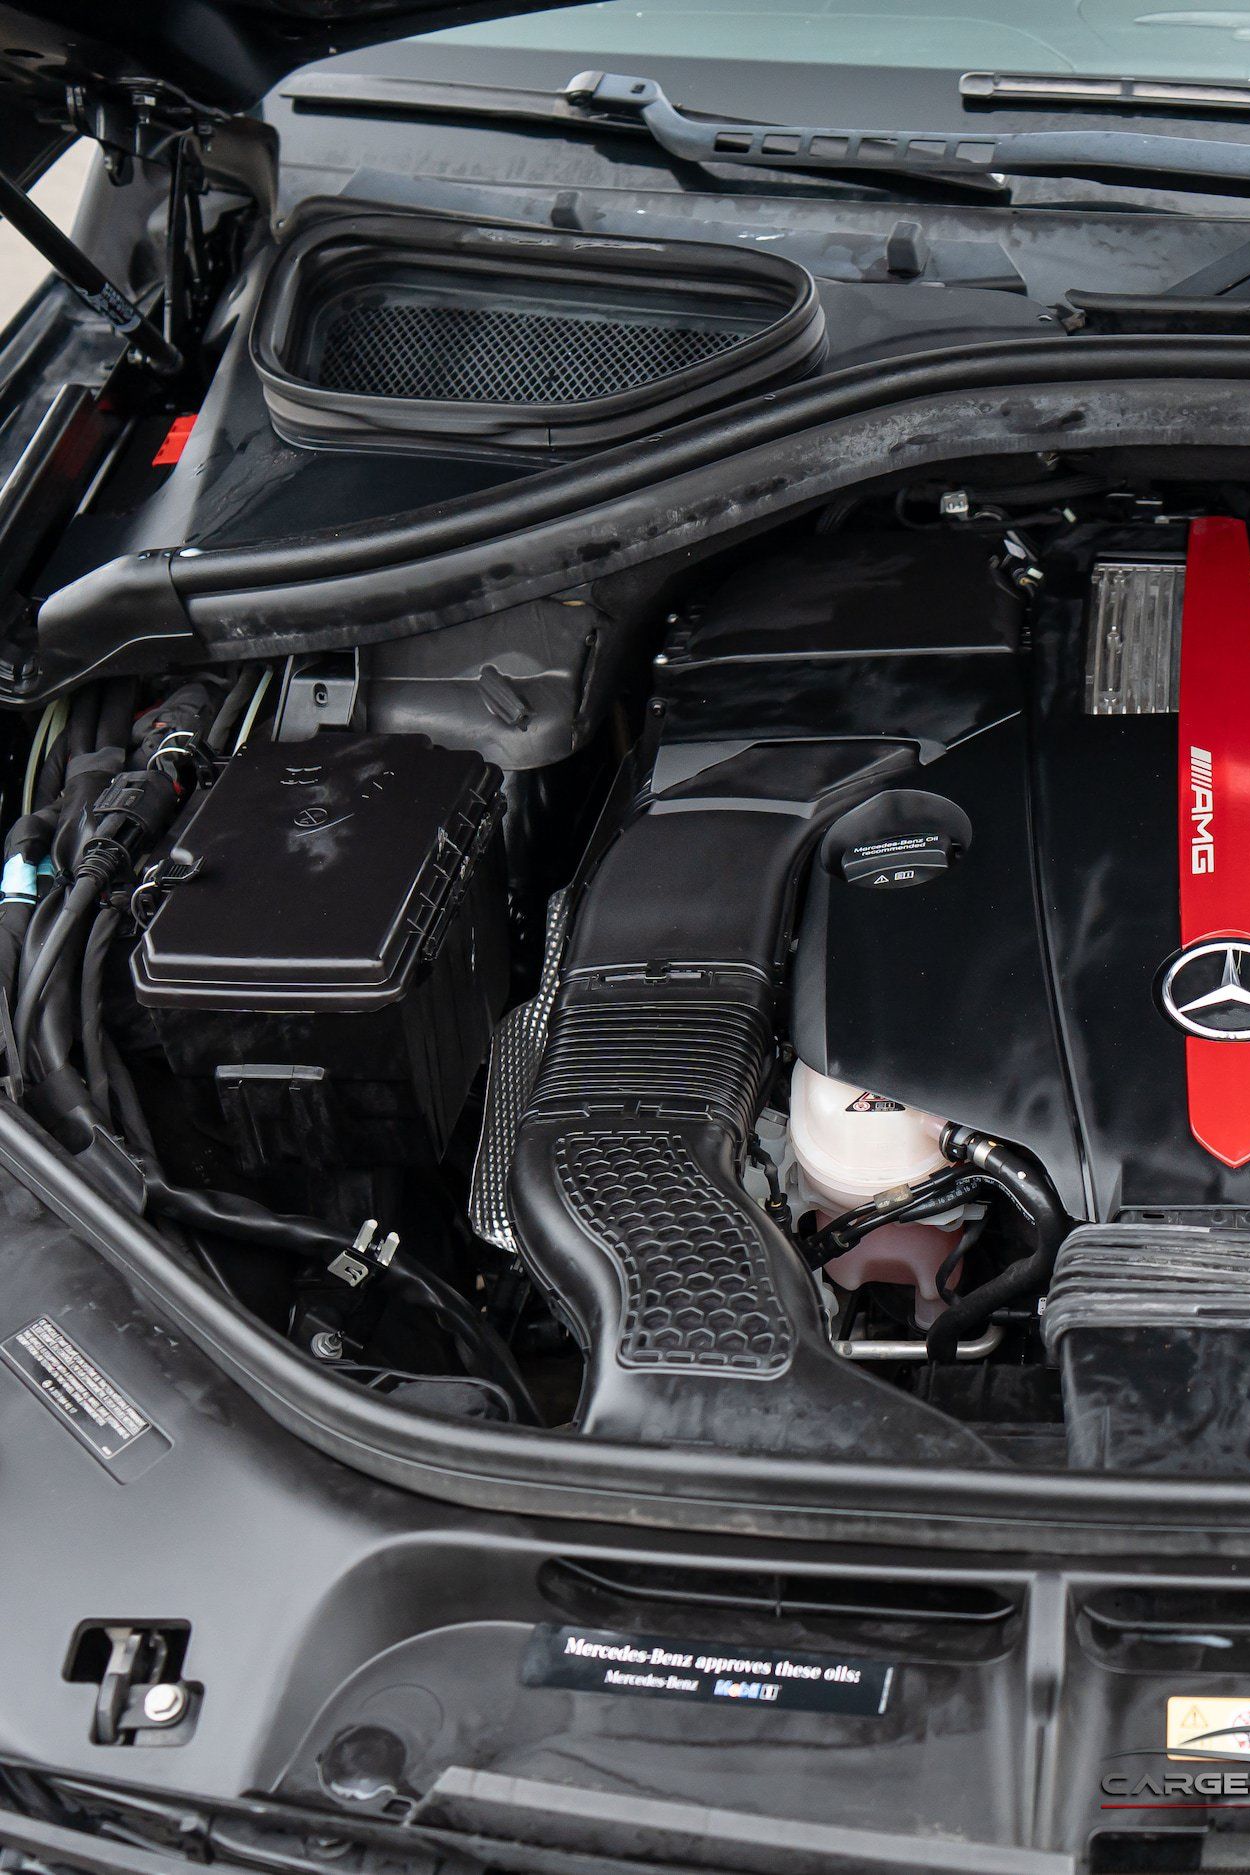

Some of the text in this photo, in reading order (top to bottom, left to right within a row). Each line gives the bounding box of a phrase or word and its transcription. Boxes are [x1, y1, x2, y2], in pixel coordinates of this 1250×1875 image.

[1190, 783, 1214, 875] AMG
[854, 838, 924, 853] Mercedes-Benz
[862, 842, 926, 857] recommended
[564, 1637, 861, 1684] Mercedes-Benz approves these oils:
[604, 1669, 699, 1692] Mercedes-Benz
[714, 1679, 760, 1700] Mobil
